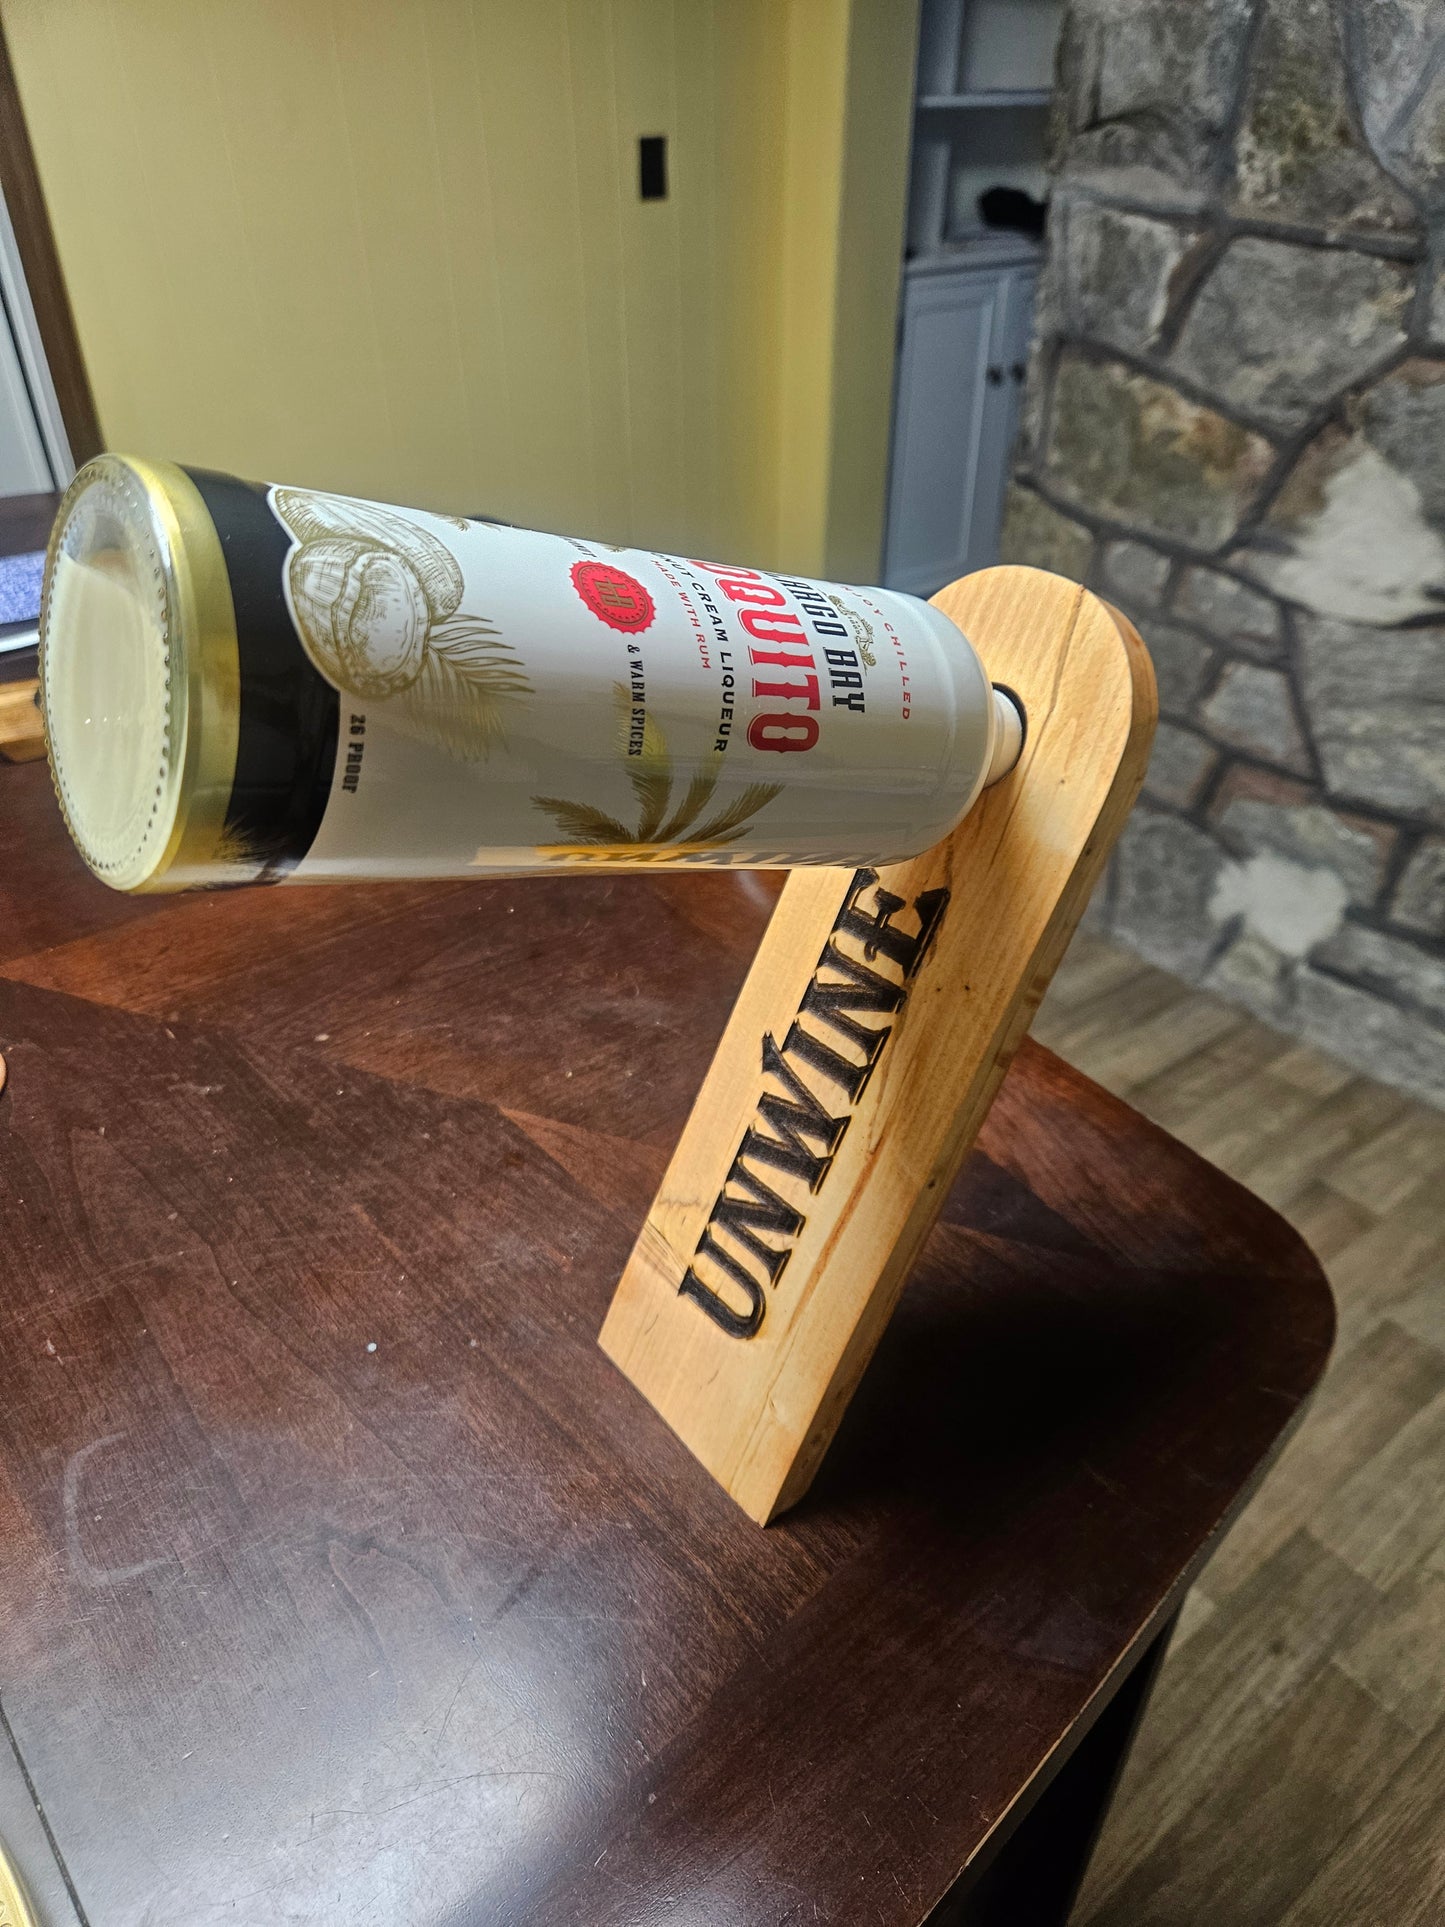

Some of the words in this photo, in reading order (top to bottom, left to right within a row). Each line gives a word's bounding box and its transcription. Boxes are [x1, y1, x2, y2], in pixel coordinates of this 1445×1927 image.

[650, 560, 682, 588] MADE
[678, 592, 701, 628] WITH
[695, 633, 712, 670] RUM
[627, 644, 641, 654] &
[629, 660, 645, 703] WARM
[684, 558, 821, 753] OQUITO
[691, 582, 730, 642] CREAM
[713, 651, 735, 752] LIQUEUR
[823, 647, 866, 713] BAY
[883, 622, 912, 720] CHILLED
[350, 714, 366, 736] 26
[628, 708, 646, 756] SPICES
[342, 742, 364, 794] PROOF
[679, 868, 951, 1340] UNWINE
